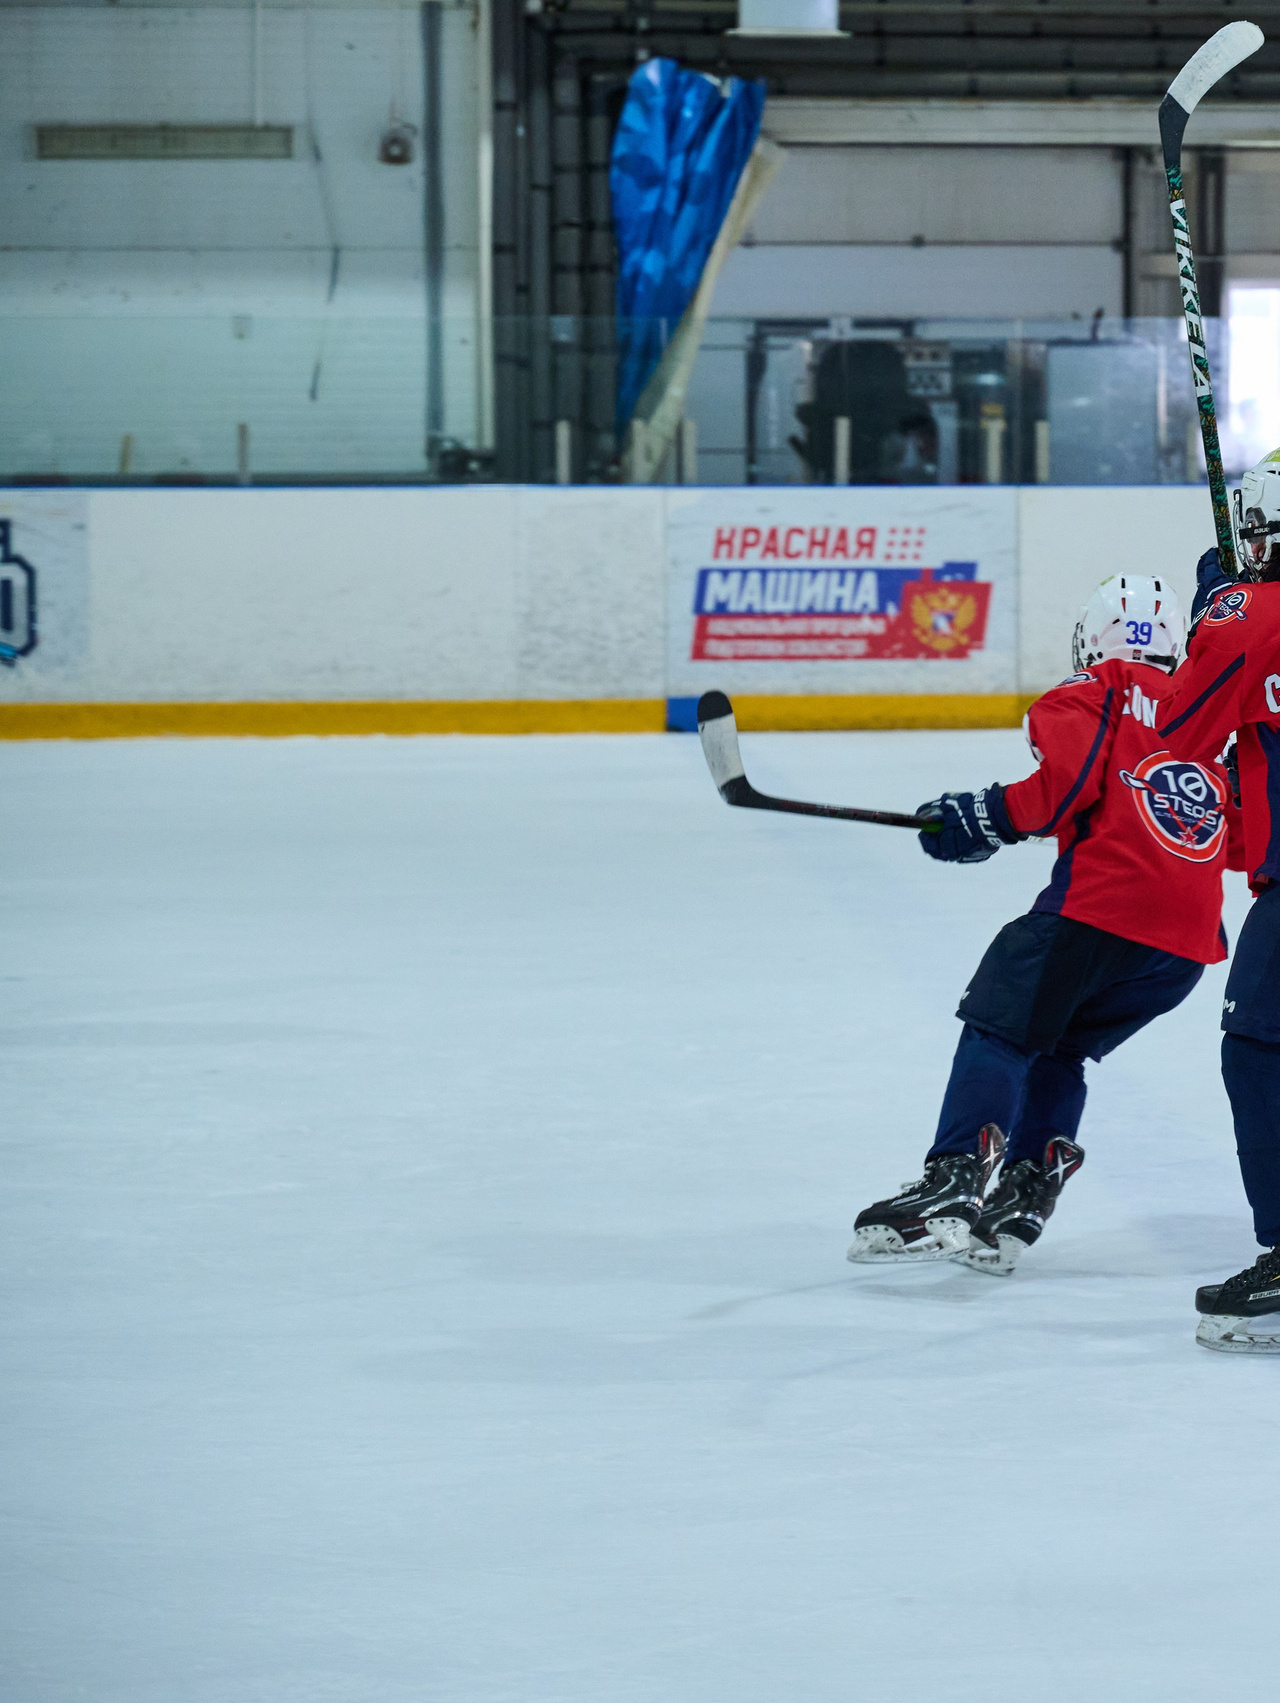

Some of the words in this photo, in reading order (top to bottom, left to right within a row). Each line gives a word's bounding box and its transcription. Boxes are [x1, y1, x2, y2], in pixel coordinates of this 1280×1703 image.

[1170, 198, 1212, 397] VIKKELA
[713, 527, 877, 559] КРАСНАЯ
[703, 571, 878, 612] МАШИНА
[1126, 621, 1152, 645] 39
[1161, 770, 1207, 802] 10
